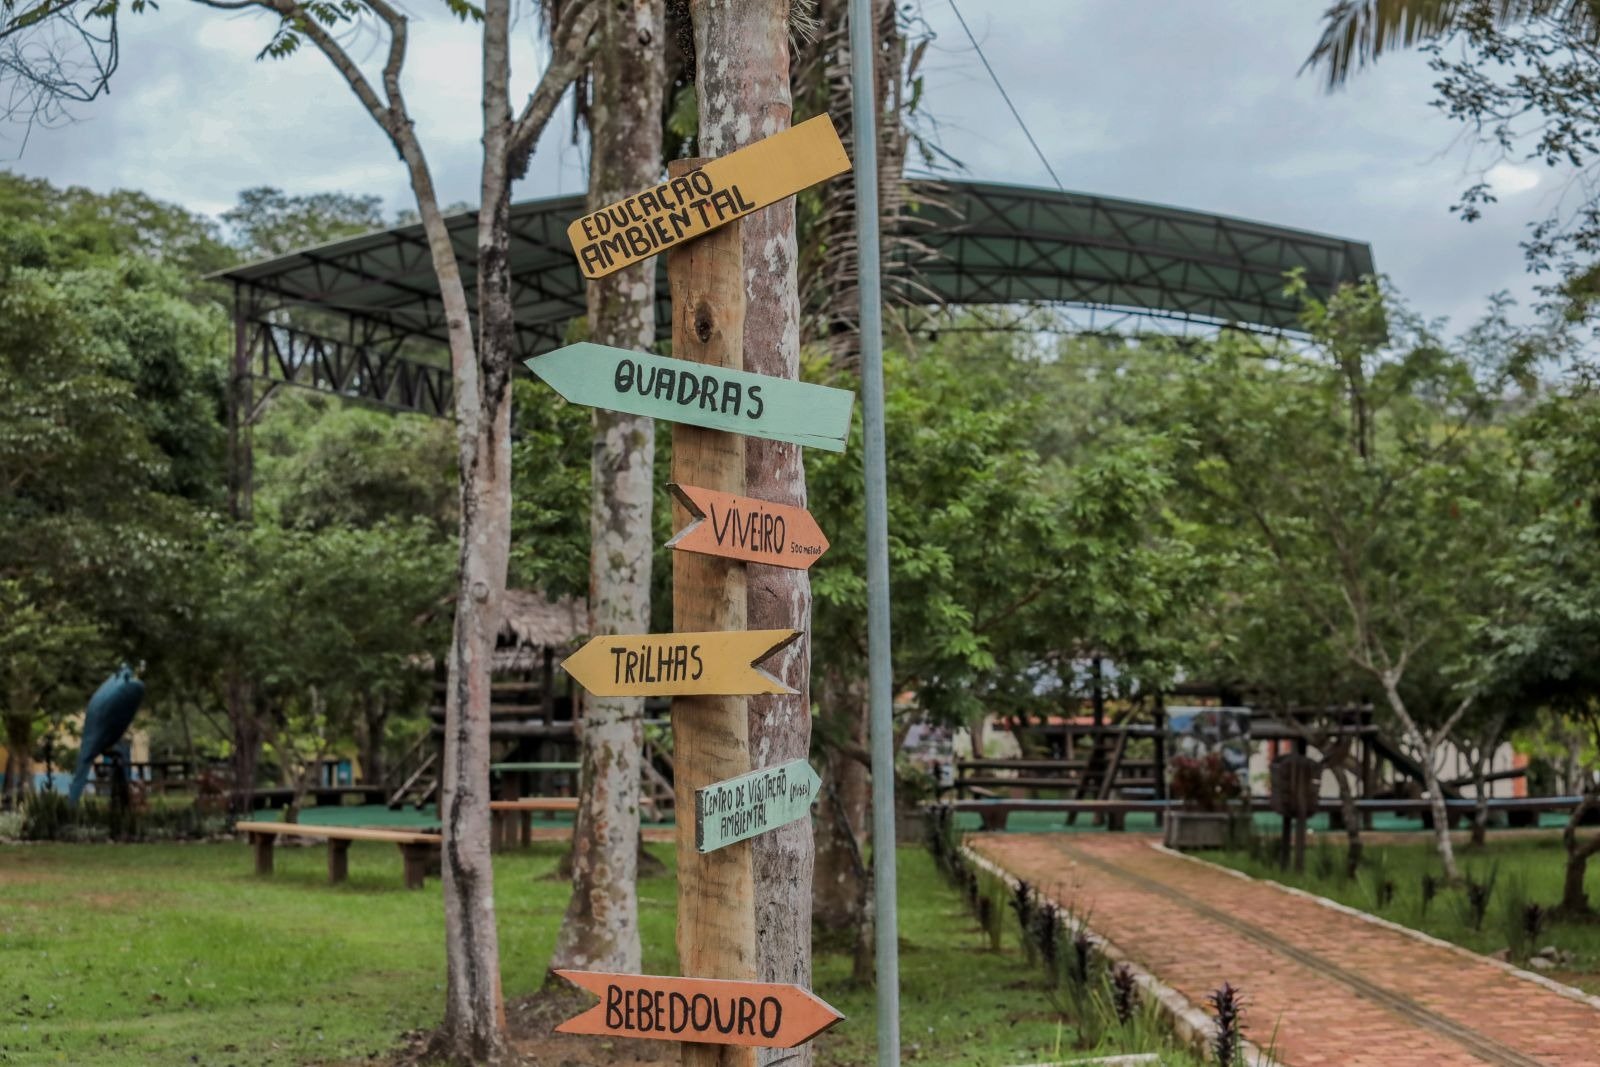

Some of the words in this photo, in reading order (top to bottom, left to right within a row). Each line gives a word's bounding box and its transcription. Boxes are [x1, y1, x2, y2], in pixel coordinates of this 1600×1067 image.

[580, 166, 714, 241] EDUCAÇÃO
[580, 184, 756, 274] AMBIENTAL
[614, 359, 764, 420] QUADRAS
[710, 499, 786, 555] VIVEIRO
[791, 541, 802, 554] 500
[610, 644, 703, 684] TRILHAS
[704, 786, 733, 817] CENTRO
[735, 784, 745, 809] DE
[747, 768, 787, 804] VISITAÇÃO
[720, 802, 768, 841] AMBIENTAL
[605, 984, 782, 1039] BEBEDOURO
